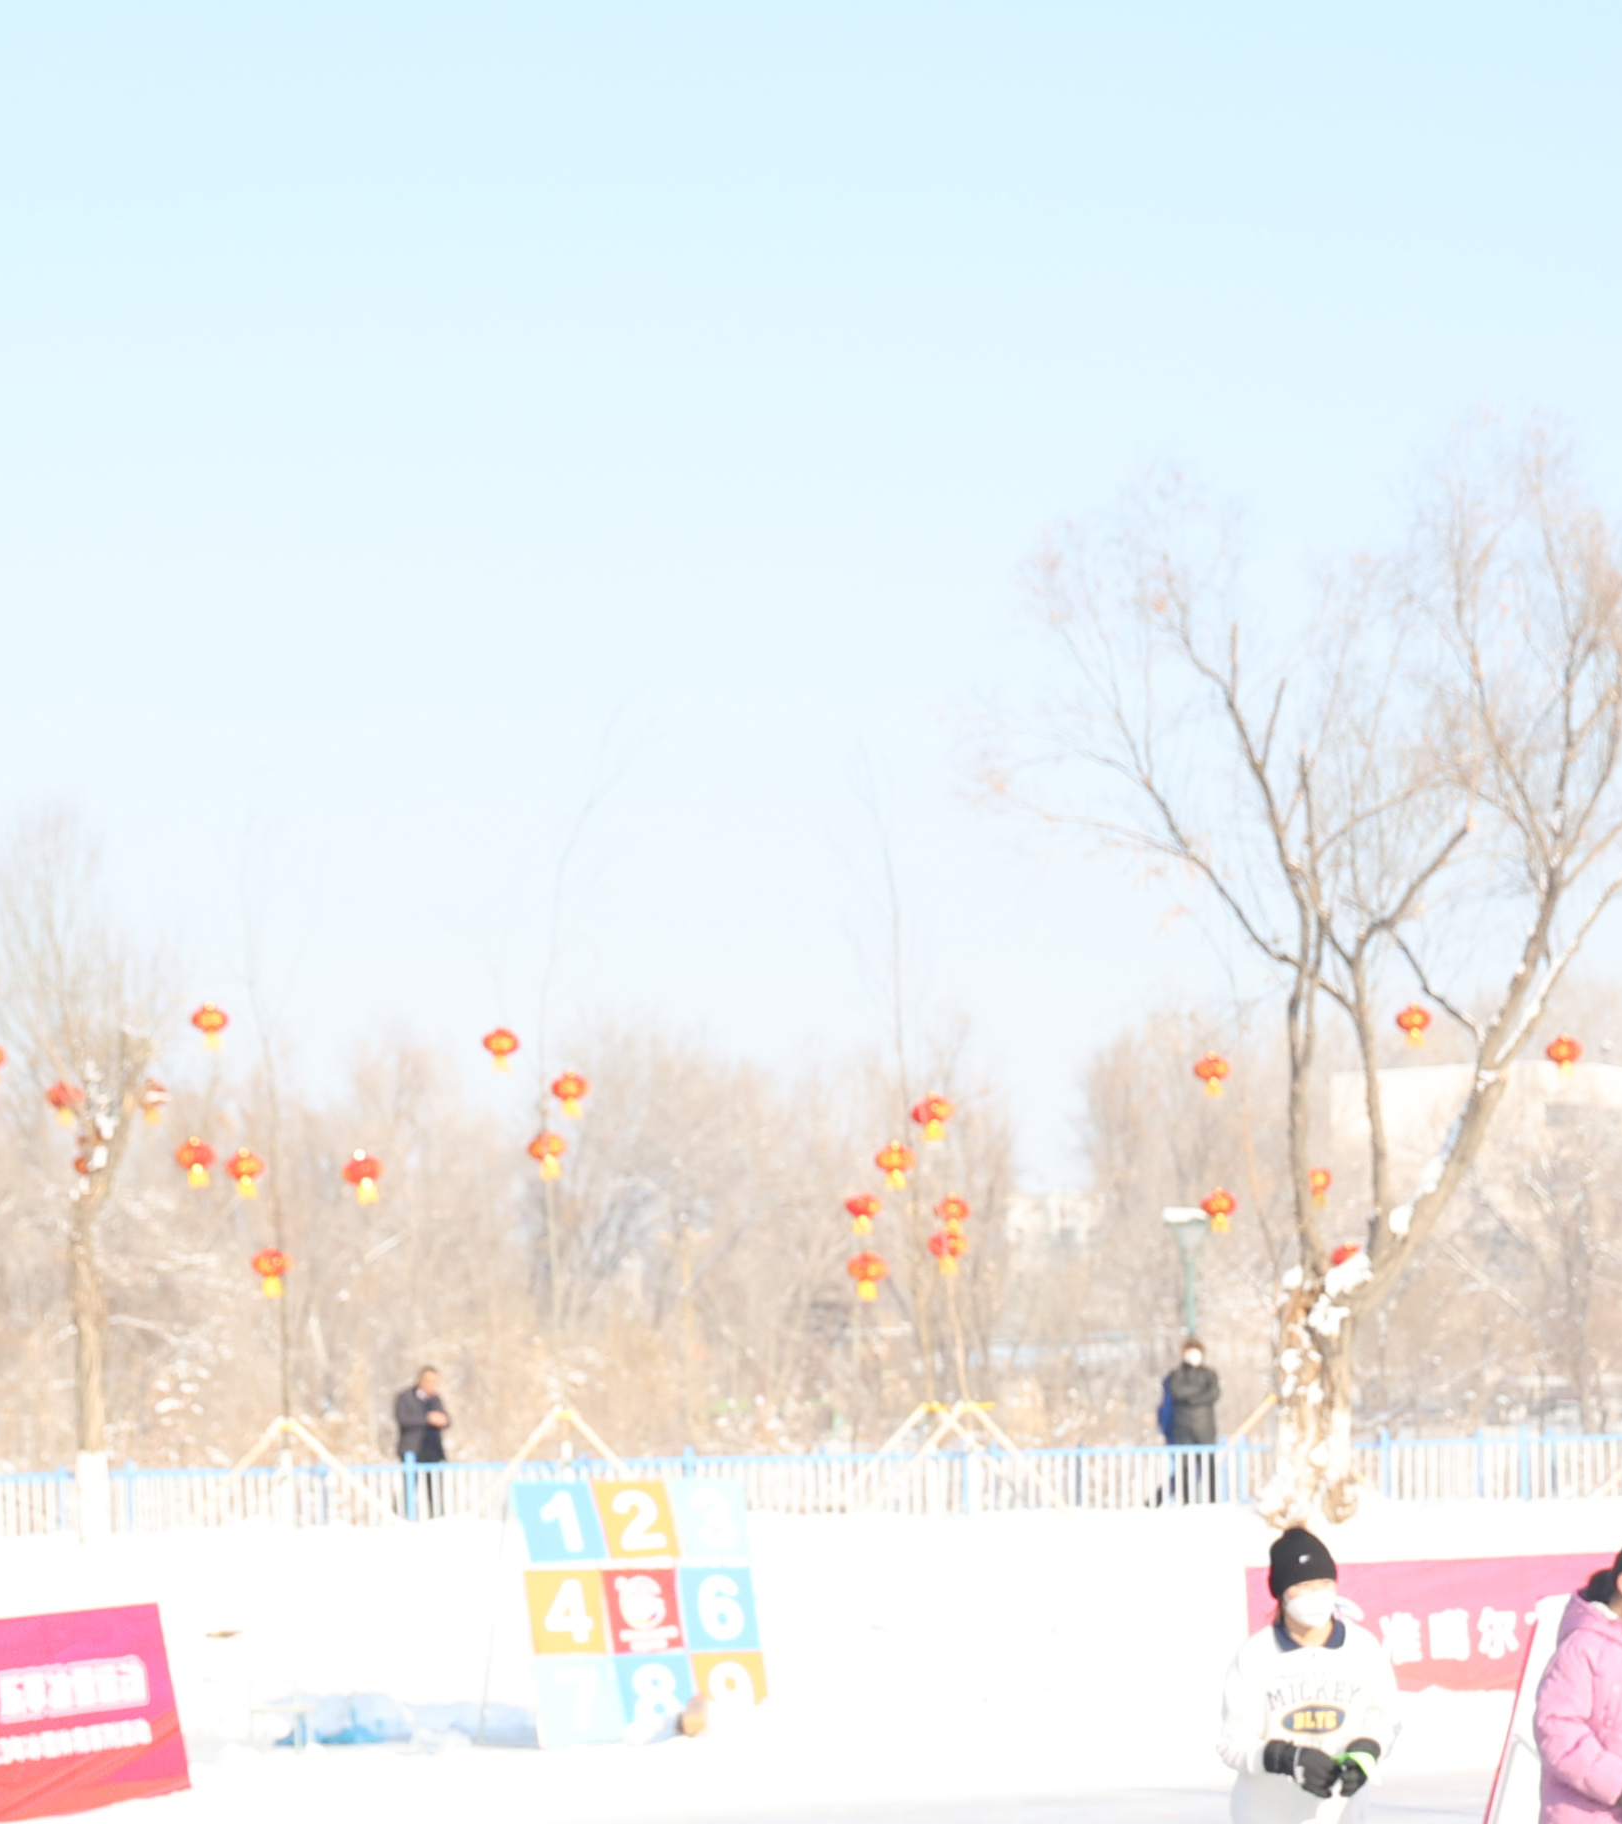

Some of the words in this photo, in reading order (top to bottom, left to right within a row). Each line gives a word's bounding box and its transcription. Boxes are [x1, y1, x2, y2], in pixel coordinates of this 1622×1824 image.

[540, 1490, 585, 1552] 1
[611, 1489, 668, 1551] 2
[689, 1487, 738, 1549] 3
[544, 1578, 594, 1644] 4
[697, 1574, 744, 1641] 6
[1379, 1606, 1537, 1665] 准噶尔
[553, 1665, 597, 1730] 7
[632, 1663, 681, 1724] 8
[1266, 1679, 1361, 1711] MICKEY
